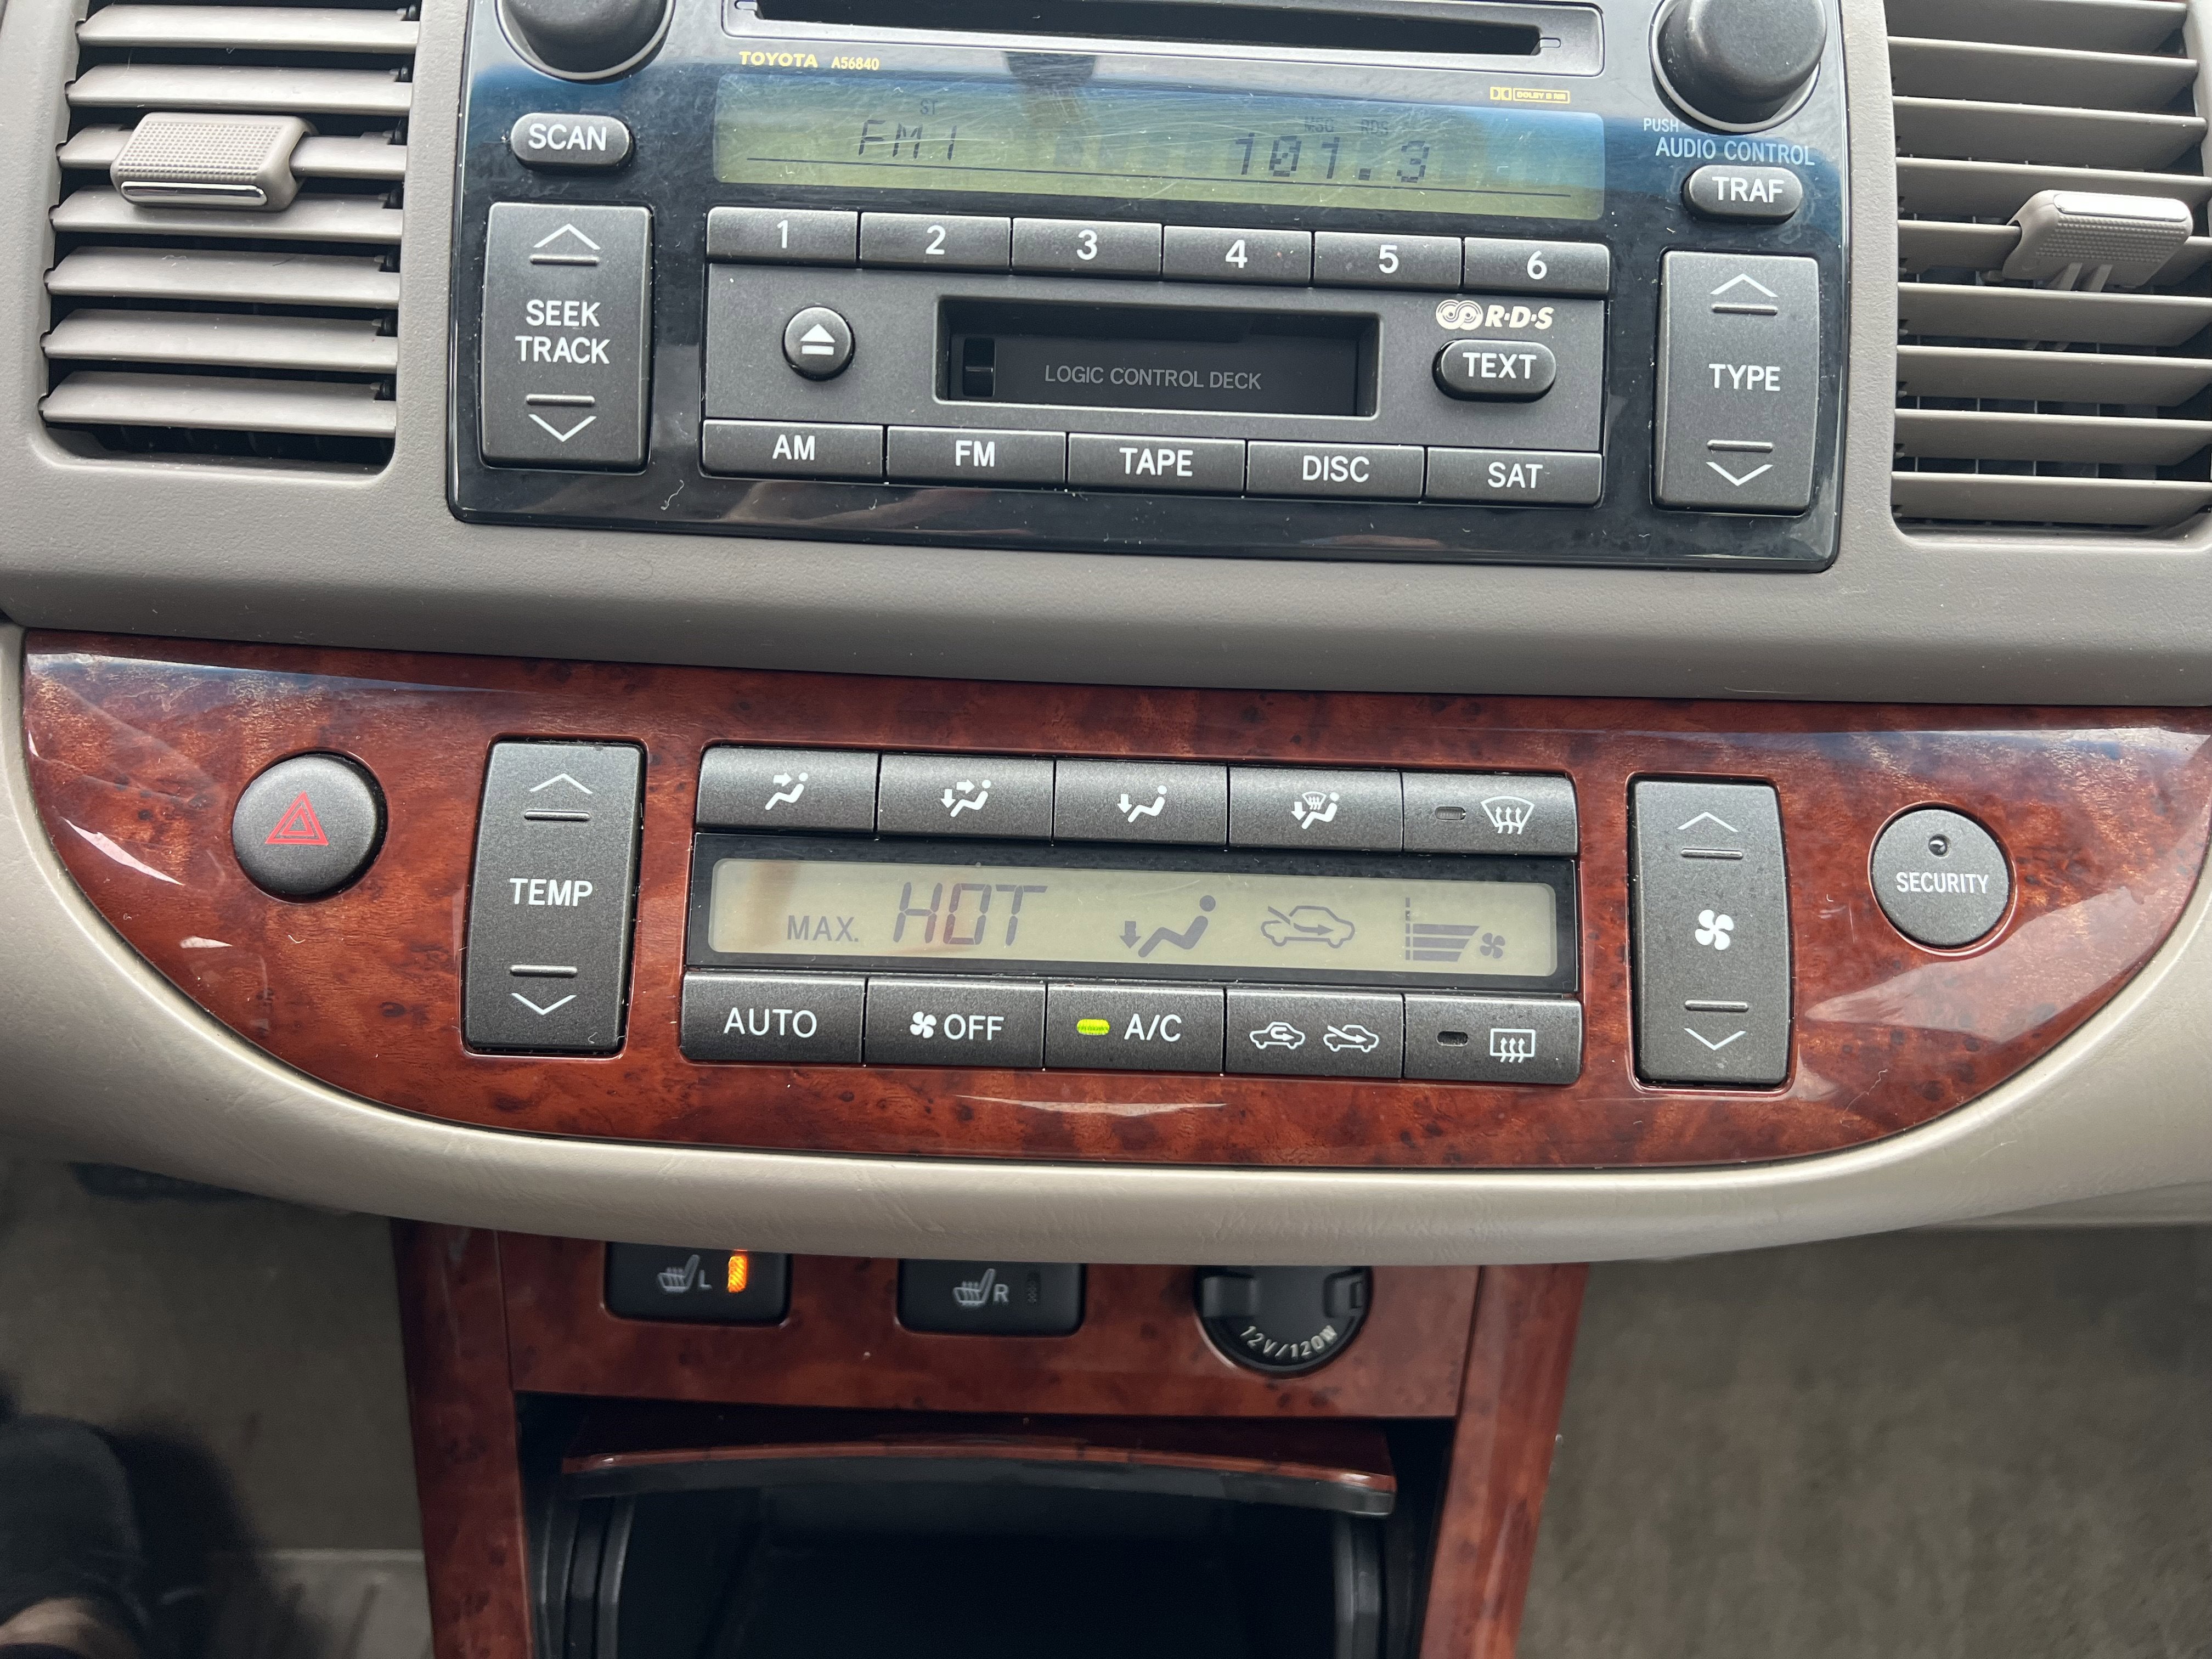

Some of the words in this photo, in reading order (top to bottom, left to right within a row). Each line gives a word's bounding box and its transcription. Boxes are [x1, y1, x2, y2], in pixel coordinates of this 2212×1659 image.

[739, 51, 818, 69] TOYOTA
[831, 56, 879, 71] A56840
[920, 99, 939, 115] ST
[528, 124, 606, 151] SCAN
[1644, 117, 1679, 132] PUSH
[858, 120, 957, 161] FM1
[1235, 133, 1430, 183] 101.3
[1655, 137, 1716, 159] AUDIO
[1724, 141, 1815, 165] CONTROL
[1712, 177, 1784, 202] TRAF
[776, 221, 788, 249] 1
[925, 225, 946, 255] 2
[1076, 230, 1098, 261] 3
[1225, 240, 1248, 268] 4
[1379, 245, 1398, 274] 5
[1527, 251, 1548, 280] 6
[526, 300, 601, 328] SEEK
[515, 335, 610, 364] TRACK
[1045, 364, 1104, 383] LOGIC
[1110, 367, 1204, 388] CONTROL
[1210, 372, 1262, 390] DECK
[1463, 352, 1536, 379] TEXT
[1708, 363, 1780, 392] TYPE
[772, 435, 815, 461] AM
[955, 441, 995, 467] FM
[1119, 447, 1193, 477] TAPE
[1302, 455, 1370, 483] DISC
[1487, 461, 1543, 489] SAT
[510, 878, 593, 907] TEMP
[1896, 871, 1989, 894] SECURITY
[787, 915, 859, 943] MAX.
[892, 881, 1048, 946] HOT
[723, 1007, 817, 1038] AUTO
[944, 1014, 1005, 1041] OFF
[1124, 1013, 1182, 1043] A/C
[698, 1269, 713, 1290] L
[994, 1284, 1009, 1303] R
[1240, 1325, 1338, 1361] 12V/120W
